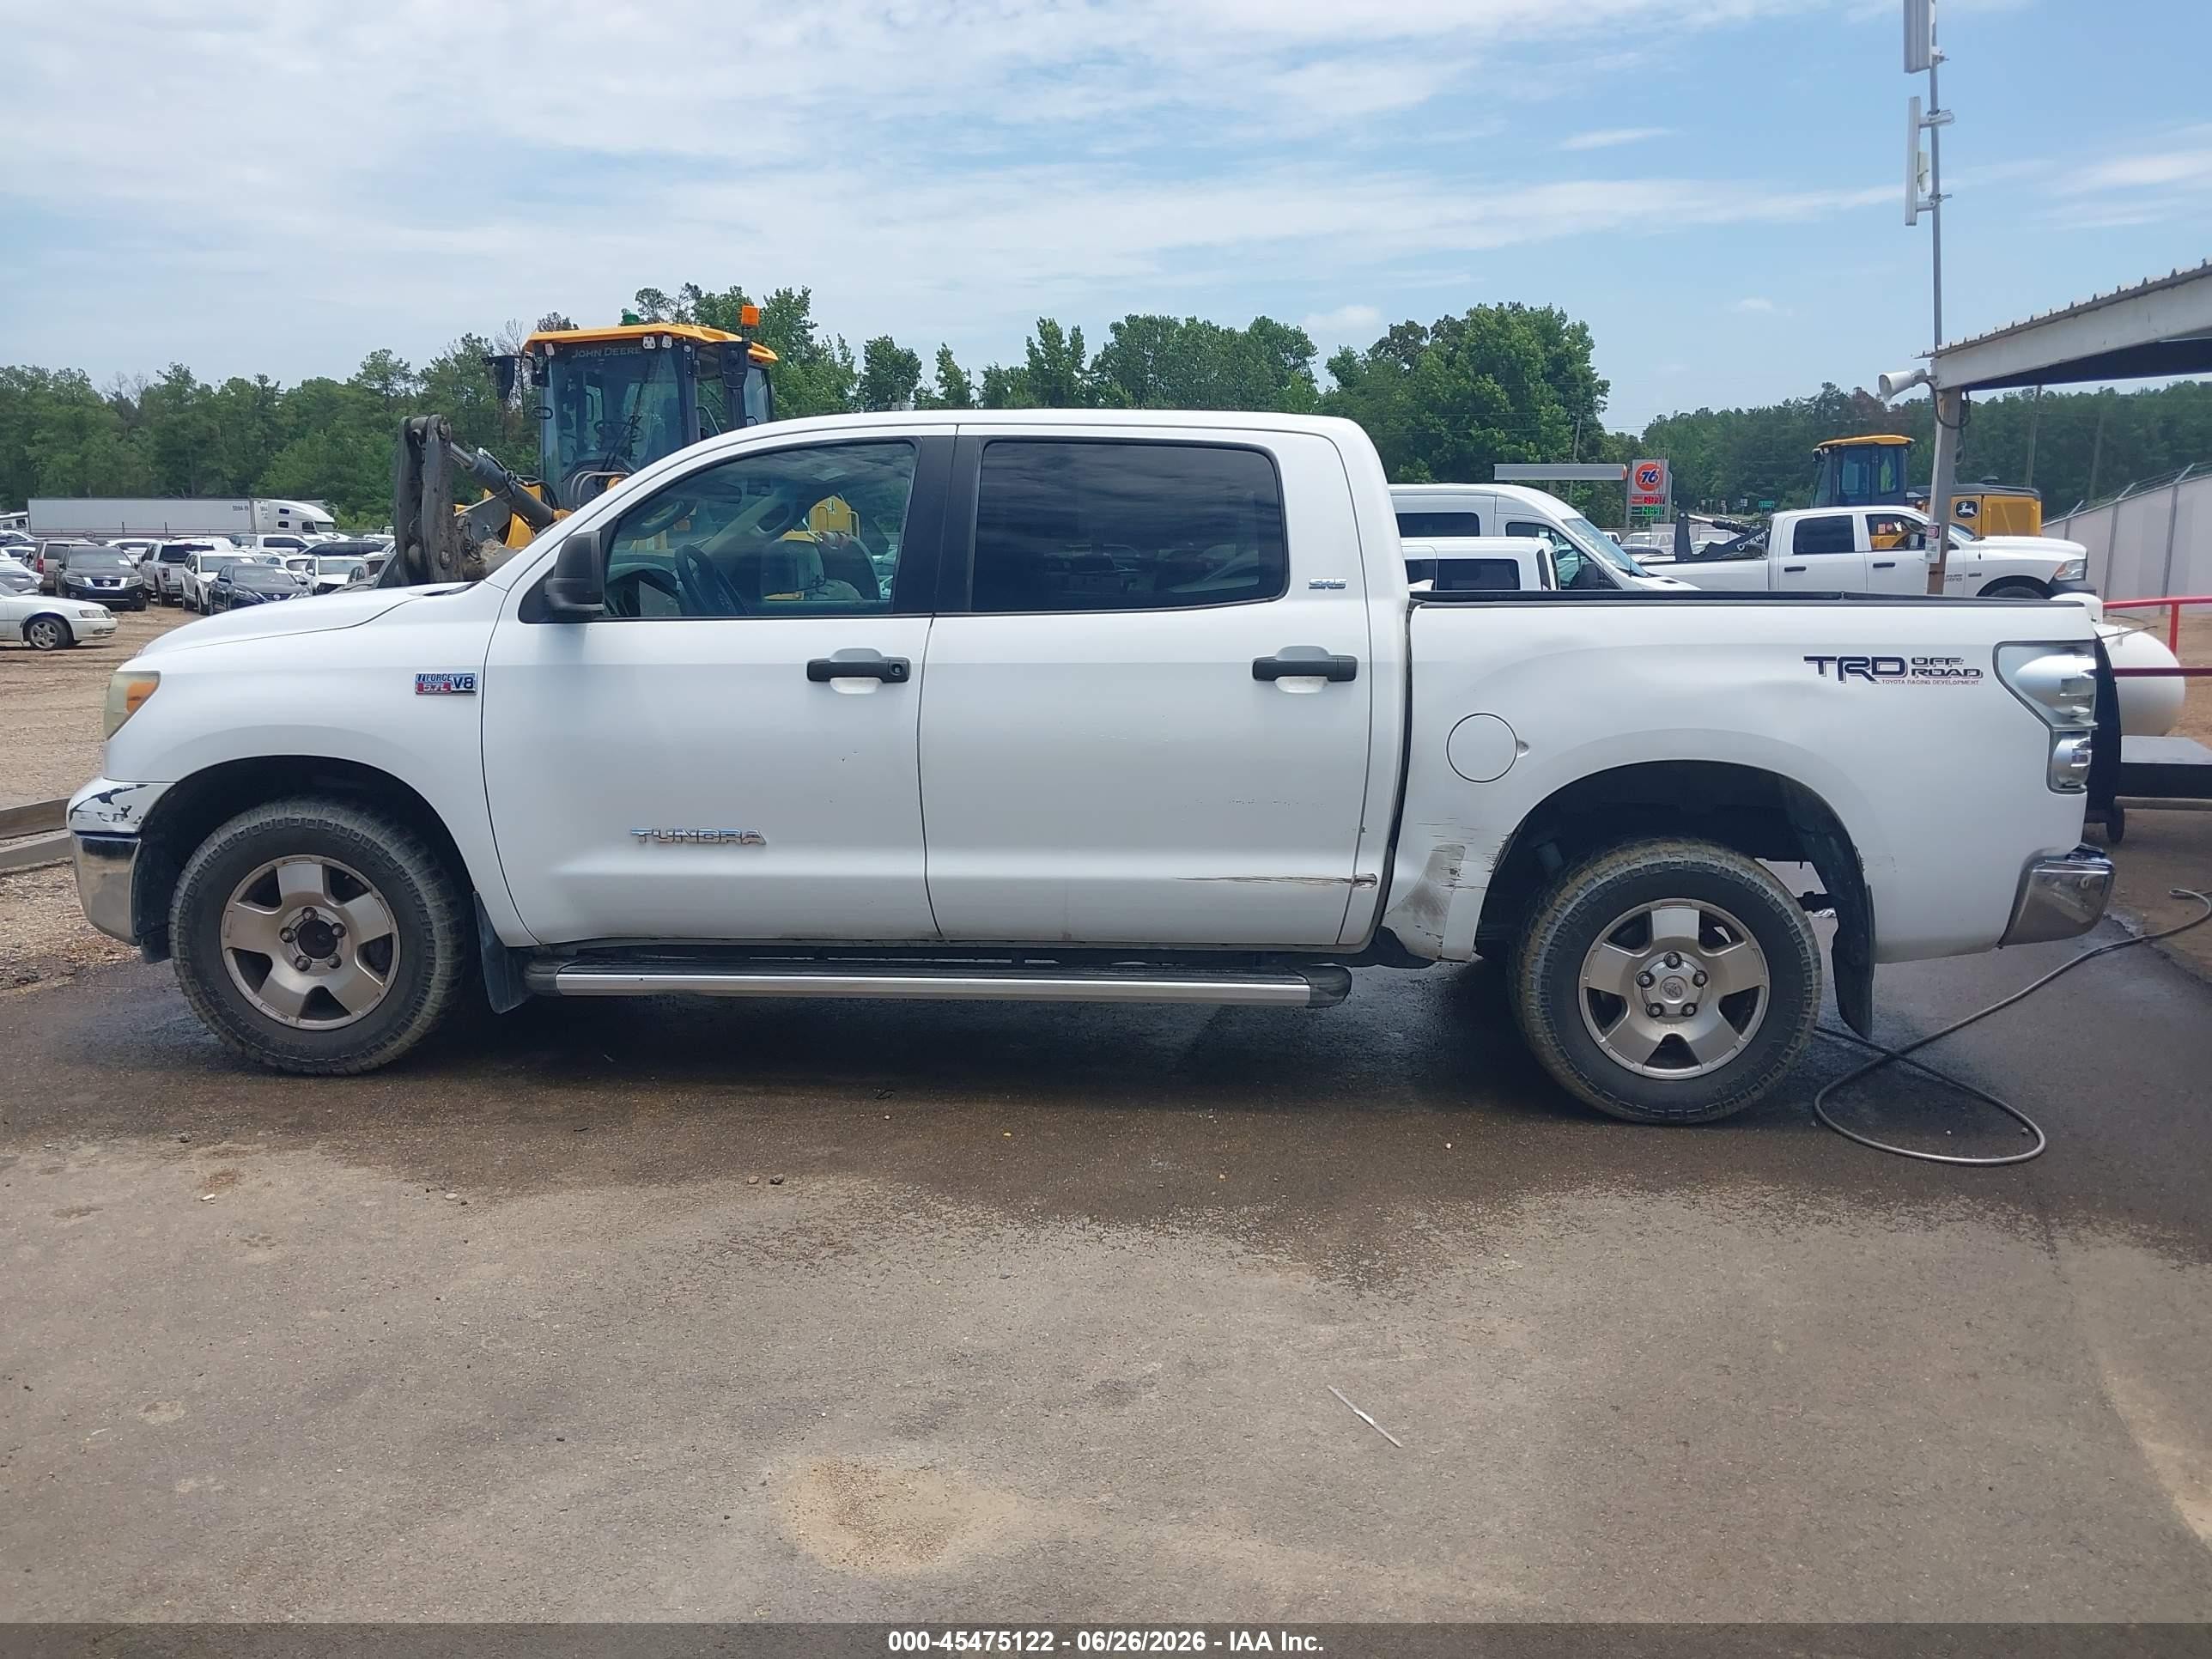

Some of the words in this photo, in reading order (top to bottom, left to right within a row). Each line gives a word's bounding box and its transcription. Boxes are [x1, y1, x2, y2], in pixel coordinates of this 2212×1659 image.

[571, 349, 601, 358] JOHN
[605, 346, 641, 356] DEERE
[1641, 469, 1658, 483] 76
[1911, 657, 1964, 667] OFF
[1803, 656, 1908, 684] TRD
[1911, 668, 1983, 678] ROAD
[453, 677, 474, 690] V8
[631, 828, 767, 845] TUNDRA
